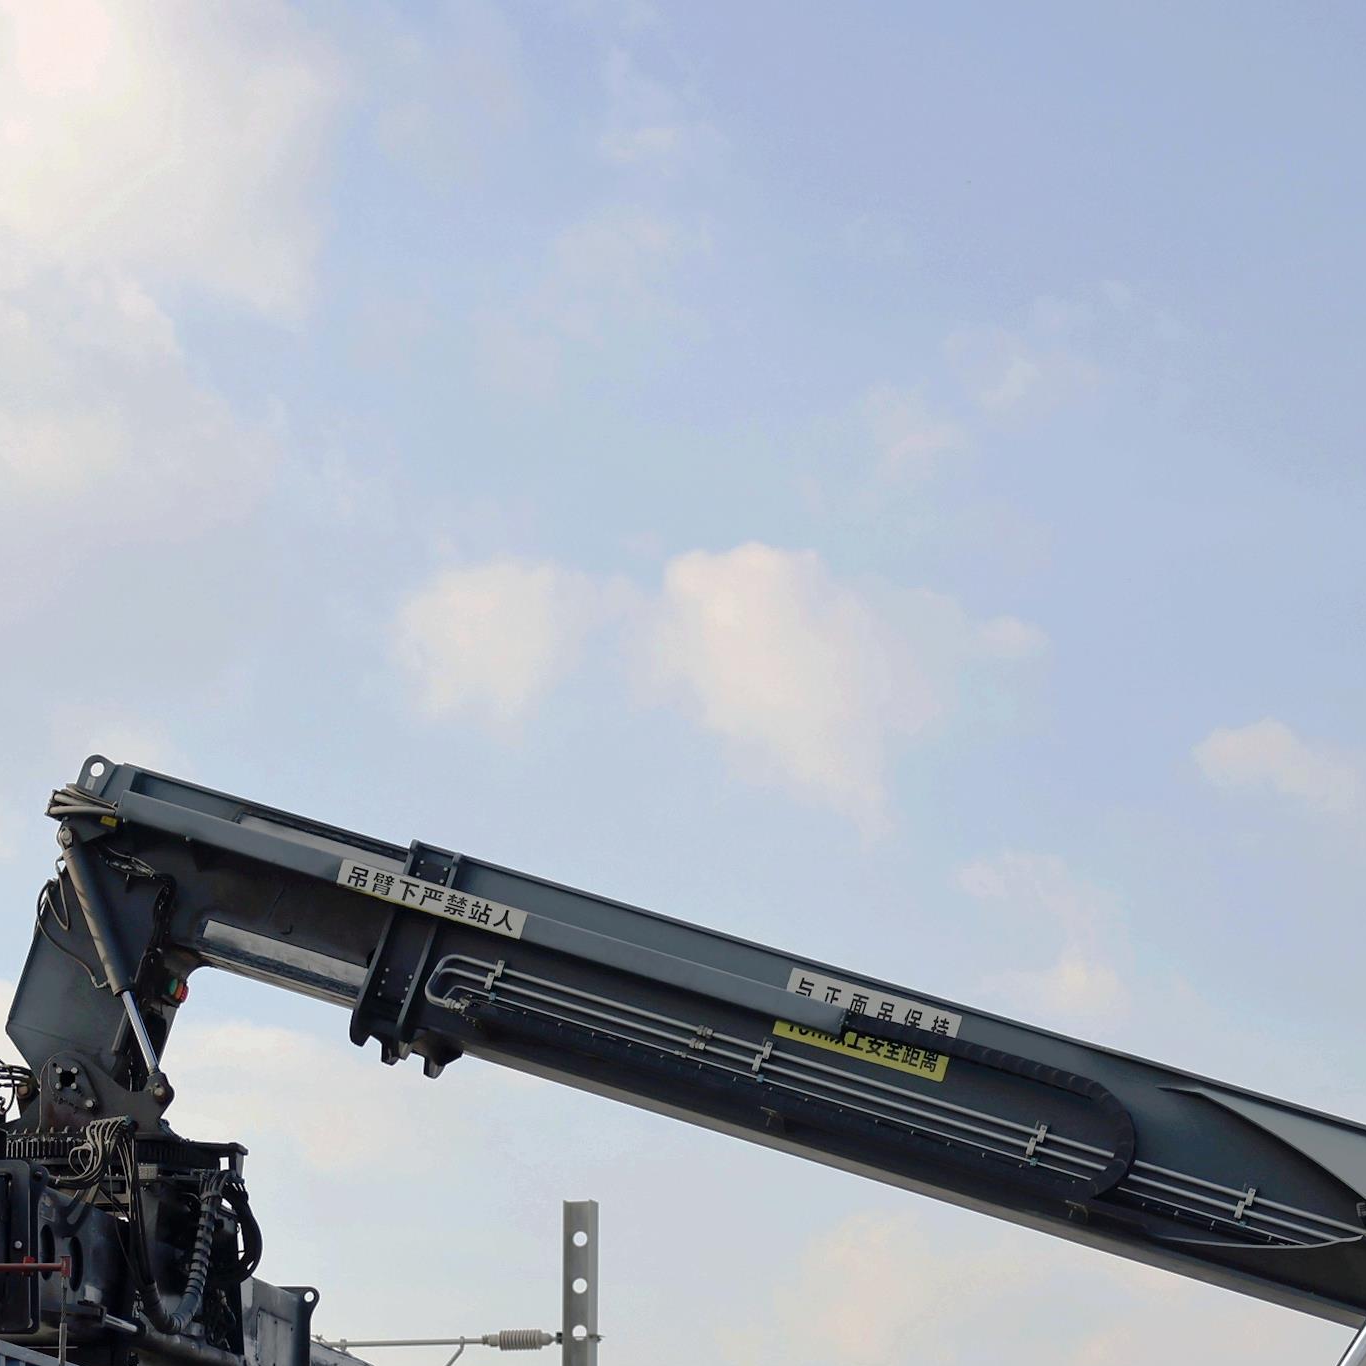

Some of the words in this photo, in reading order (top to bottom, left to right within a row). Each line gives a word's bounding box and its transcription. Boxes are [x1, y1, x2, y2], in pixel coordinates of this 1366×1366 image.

[347, 866, 513, 932] 吊臂下严禁站人
